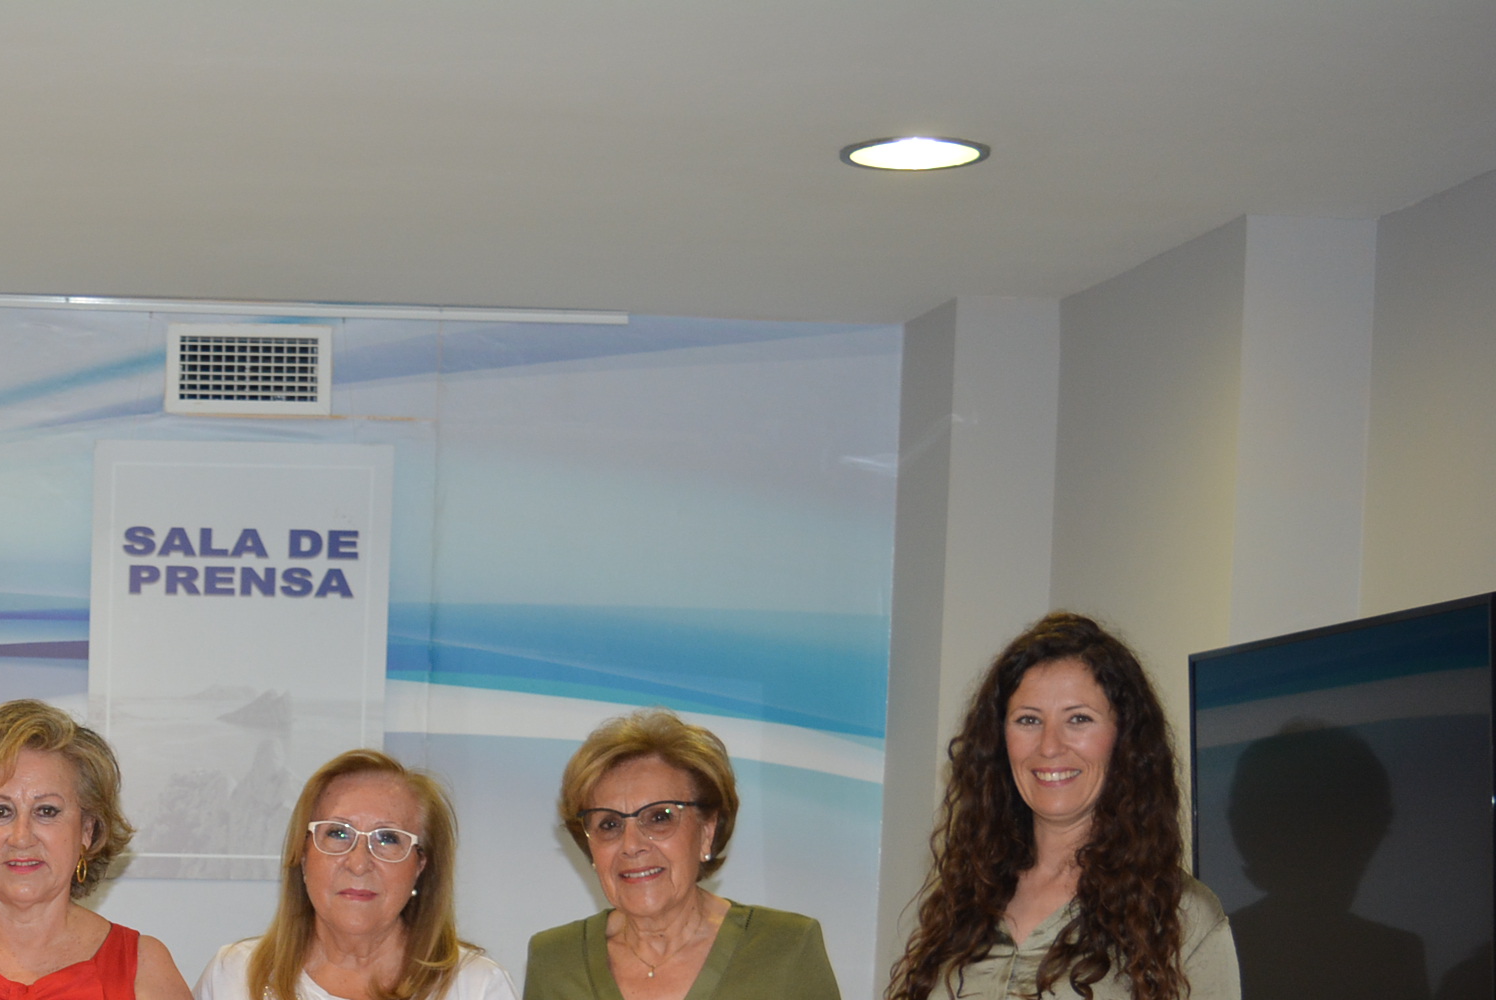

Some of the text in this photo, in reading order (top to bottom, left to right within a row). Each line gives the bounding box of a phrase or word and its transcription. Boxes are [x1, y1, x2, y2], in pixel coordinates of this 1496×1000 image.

[123, 526, 361, 560] SALA DE
[128, 565, 354, 598] PRENSA
